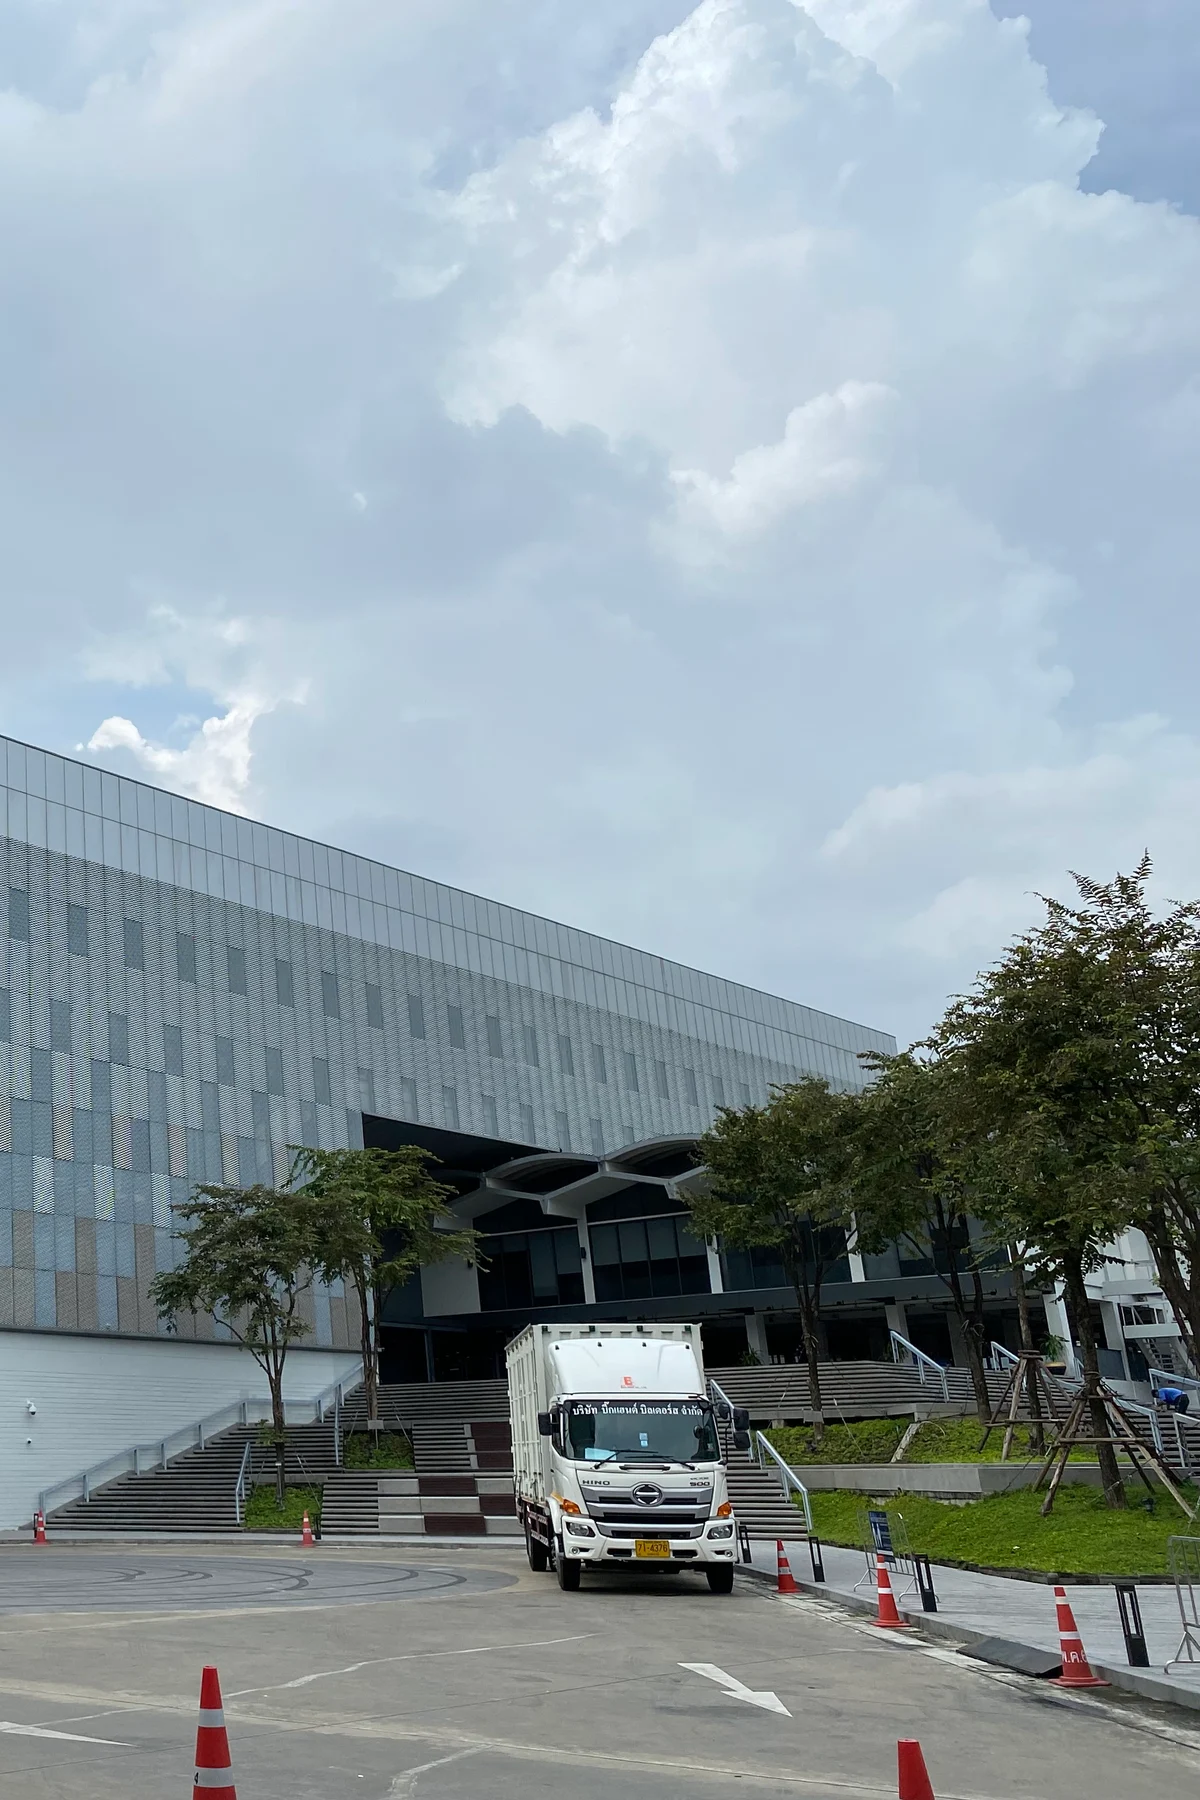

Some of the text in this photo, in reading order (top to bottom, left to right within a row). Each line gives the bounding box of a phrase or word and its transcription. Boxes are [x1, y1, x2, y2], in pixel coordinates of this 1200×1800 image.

[572, 1404, 598, 1415] บริษัท
[681, 1405, 703, 1416] จำกัด
[637, 1543, 668, 1553] 71-4376
